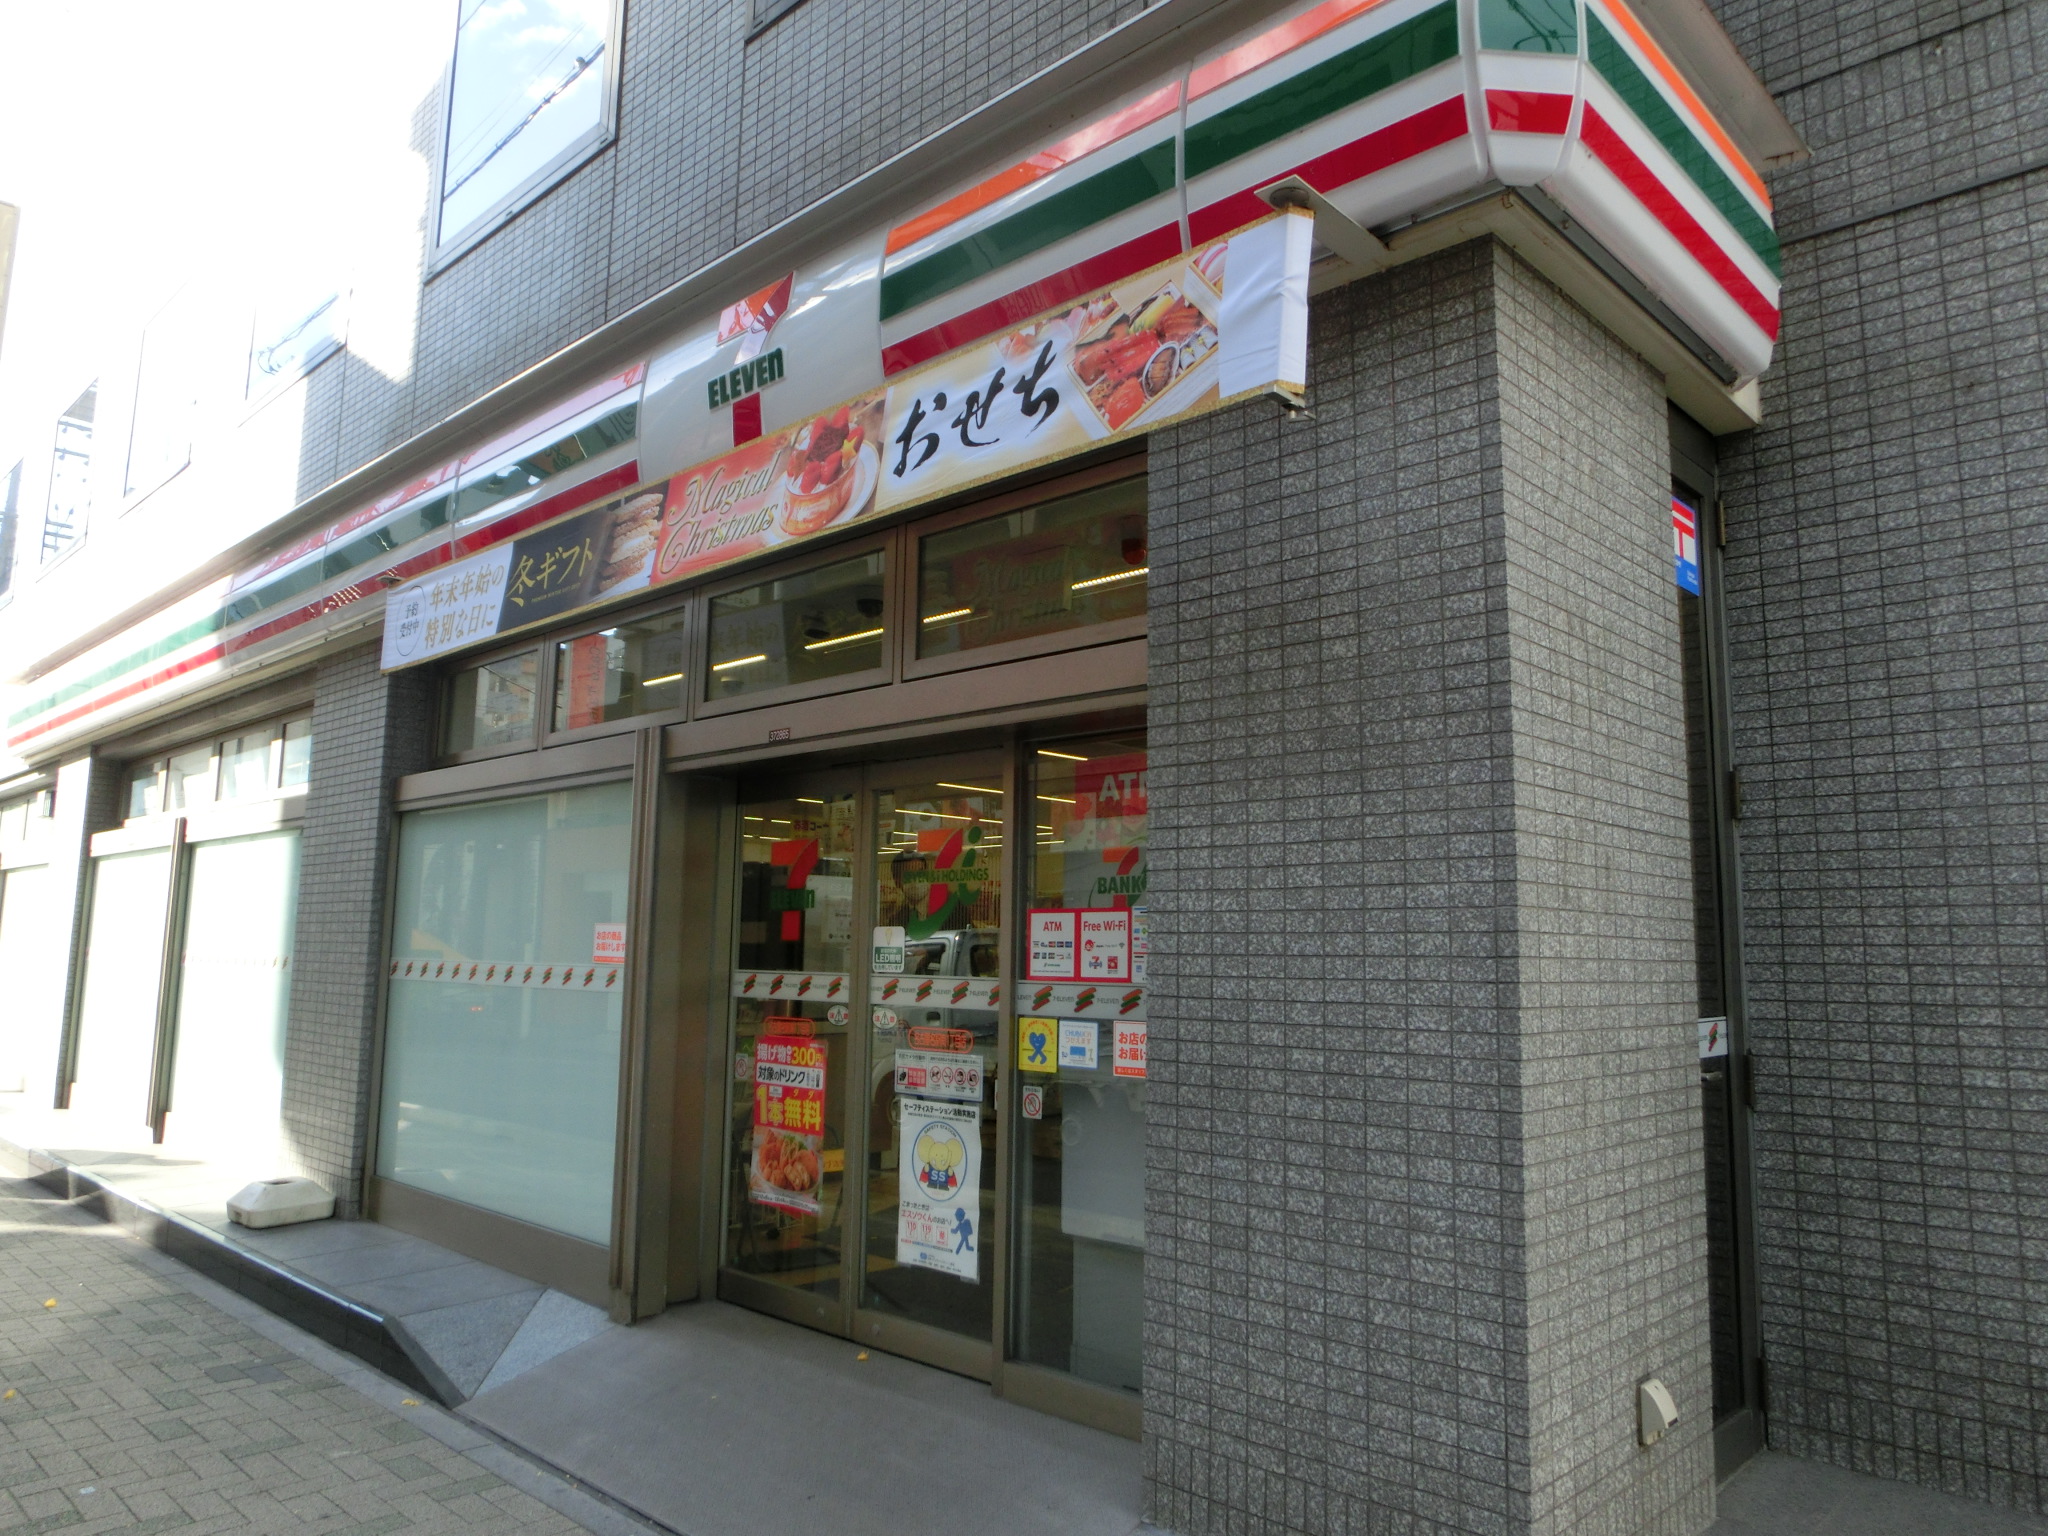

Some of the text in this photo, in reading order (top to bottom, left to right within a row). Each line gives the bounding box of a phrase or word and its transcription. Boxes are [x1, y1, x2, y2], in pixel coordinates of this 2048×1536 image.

[893, 340, 1060, 477] おせち
[667, 450, 782, 526] Magical
[660, 503, 778, 574] Christmas
[430, 563, 505, 612] 年末年始の
[506, 537, 593, 607] 冬ギフト
[425, 604, 496, 650] 特別な日に
[942, 868, 989, 882] HOLDINGS
[1097, 875, 1141, 894] BANK
[1043, 921, 1062, 931] ATM
[1083, 920, 1126, 931] Free Wi-Fi
[758, 1065, 806, 1084] 対象のドリンク
